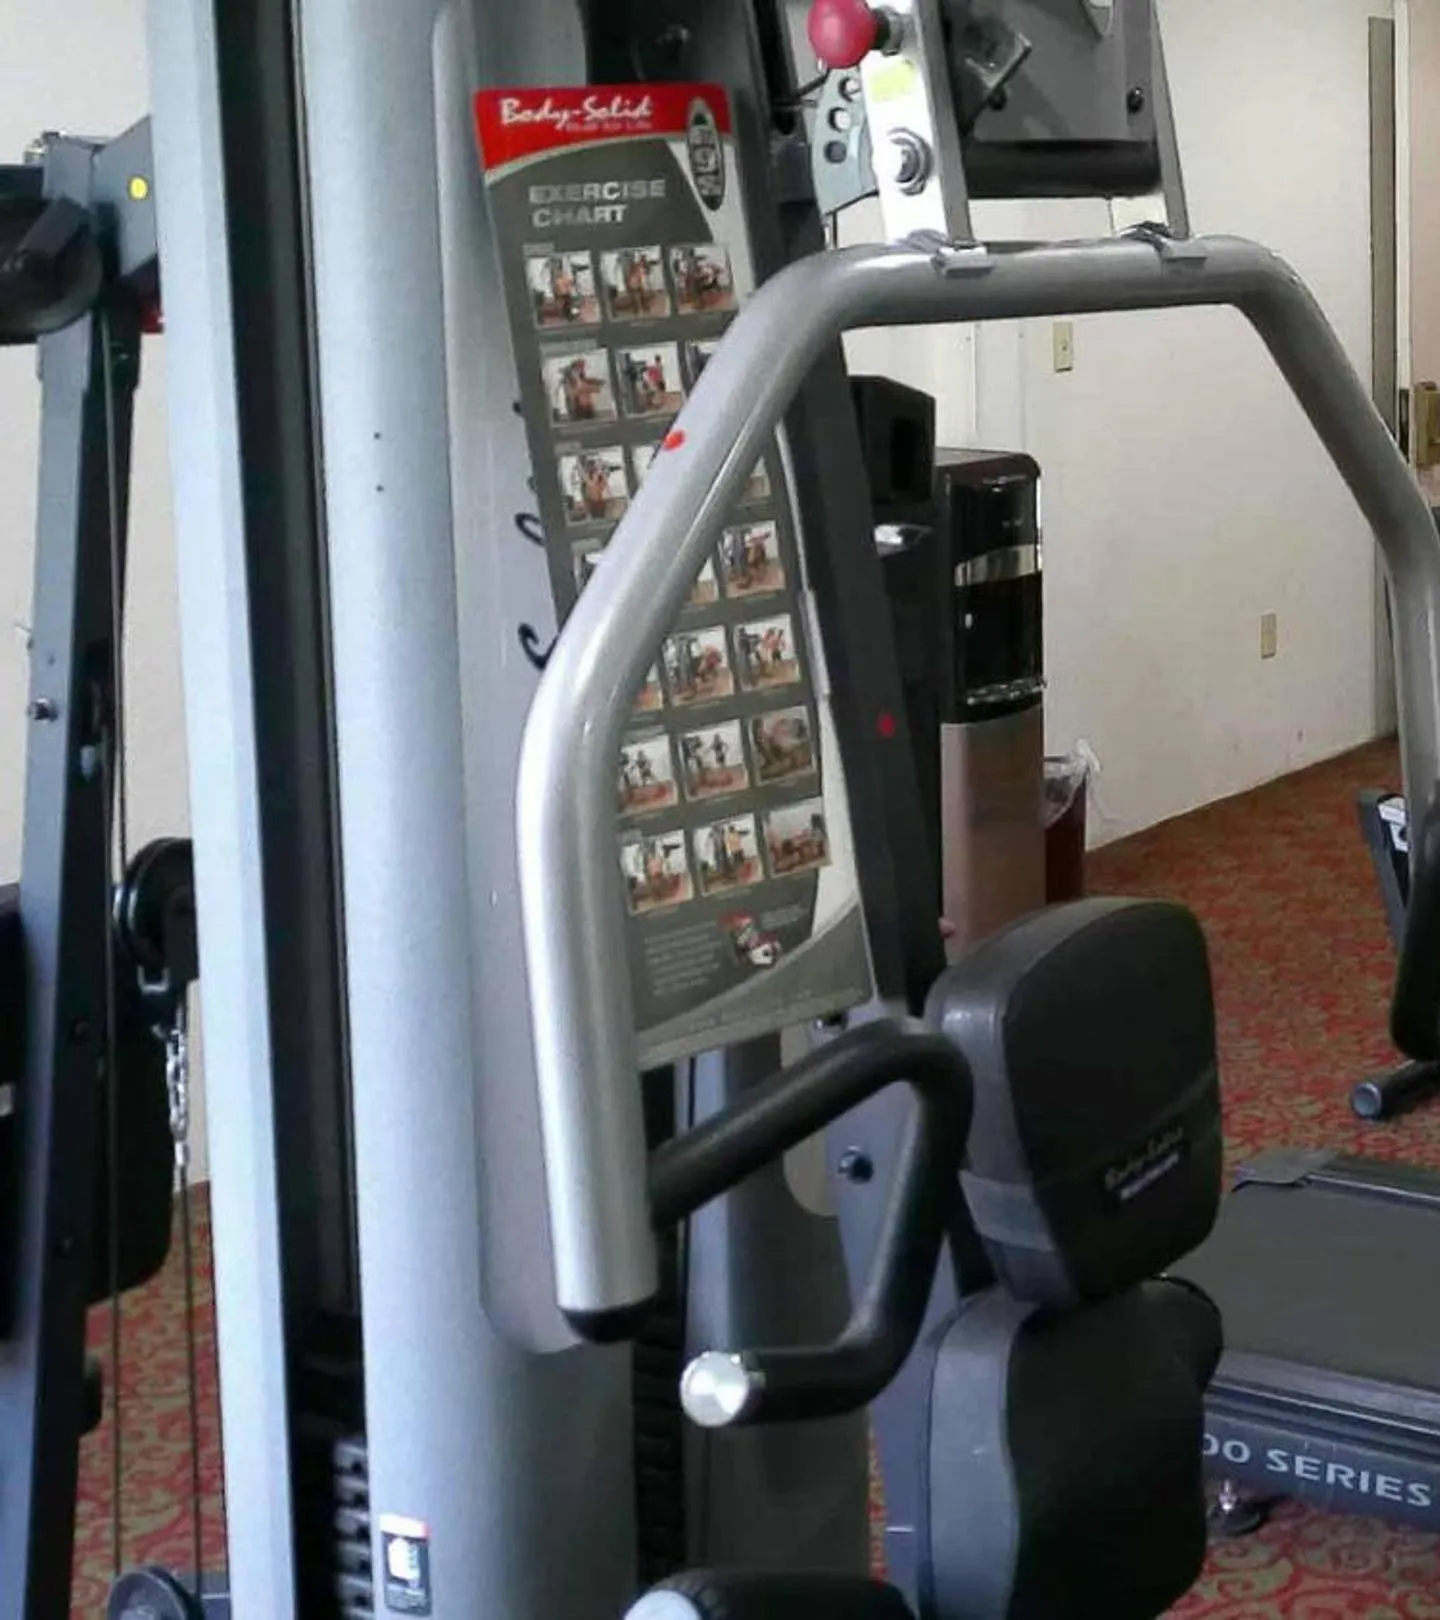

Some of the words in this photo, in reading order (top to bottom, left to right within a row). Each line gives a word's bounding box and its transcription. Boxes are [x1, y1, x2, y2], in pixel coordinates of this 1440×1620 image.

[500, 94, 653, 130] Body-Solid
[528, 179, 667, 203] EXERCISE
[532, 204, 628, 227] CHART
[1266, 1449, 1431, 1507] SERIES
